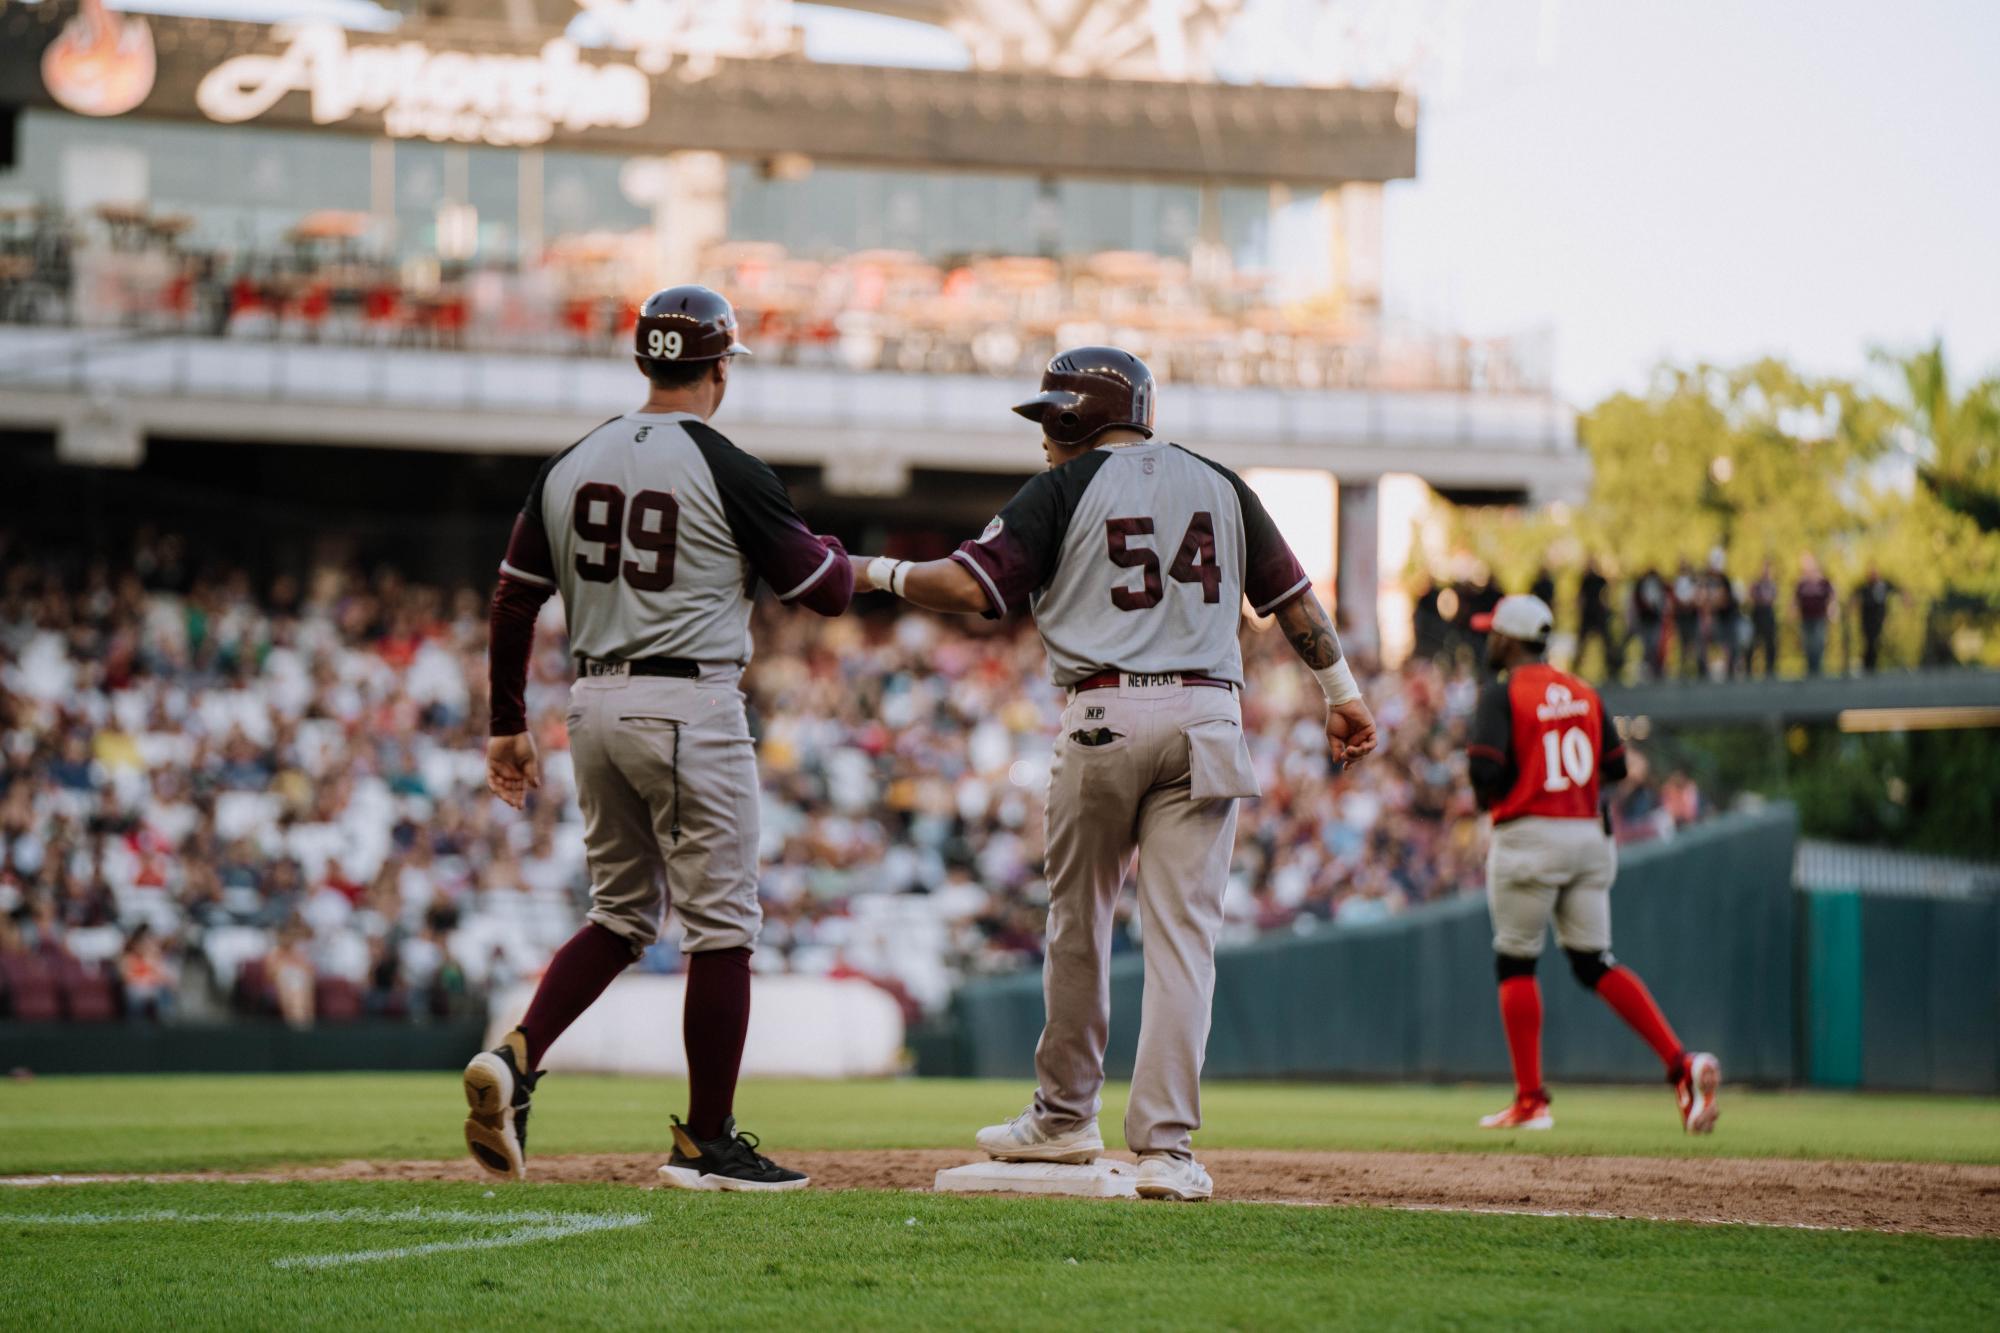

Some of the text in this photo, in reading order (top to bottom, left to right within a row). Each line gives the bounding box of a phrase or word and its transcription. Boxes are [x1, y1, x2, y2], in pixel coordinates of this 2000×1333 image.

[648, 329, 683, 360] 99
[574, 482, 679, 592] 99
[1106, 511, 1222, 611] 54
[1128, 673, 1148, 688] NEW
[1086, 708, 1104, 719] NP
[1542, 726, 1593, 792] 10
